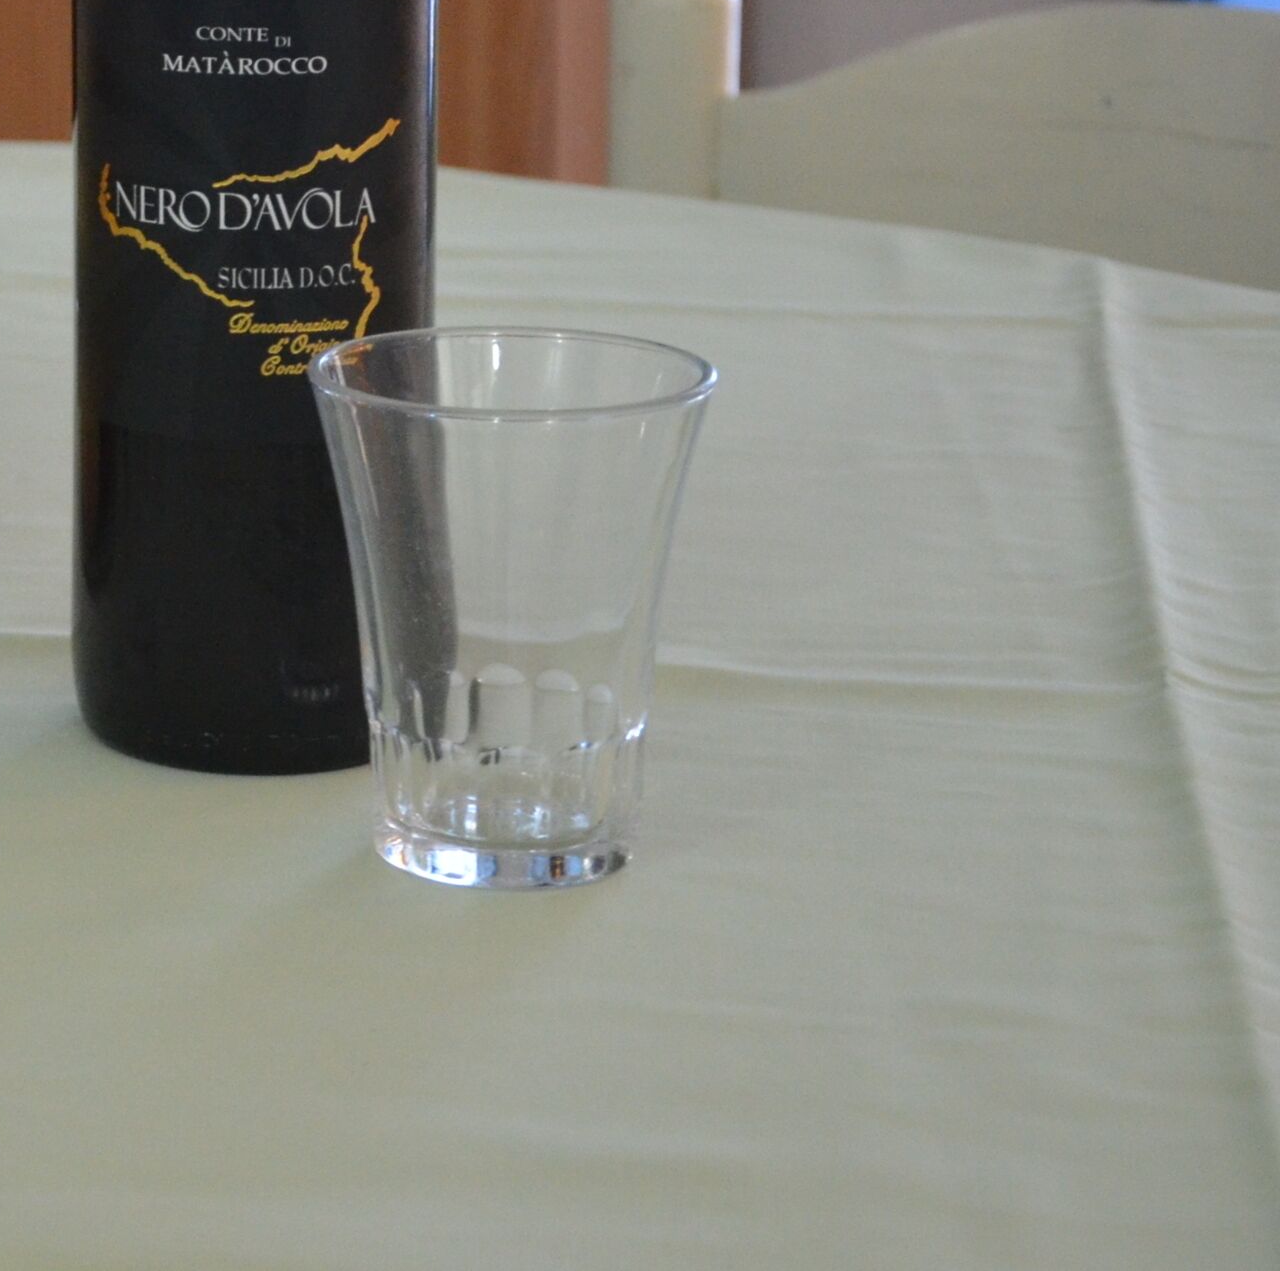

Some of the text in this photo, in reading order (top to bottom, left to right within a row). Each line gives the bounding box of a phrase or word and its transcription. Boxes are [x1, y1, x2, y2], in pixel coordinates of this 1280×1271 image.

[195, 26, 292, 48] CONTE DI
[162, 50, 328, 76] MATÀROCCO
[115, 180, 376, 232] NERO D'AVOLA
[217, 263, 356, 290] SICILIA D.O.C.
[228, 312, 350, 335] Denominazione
